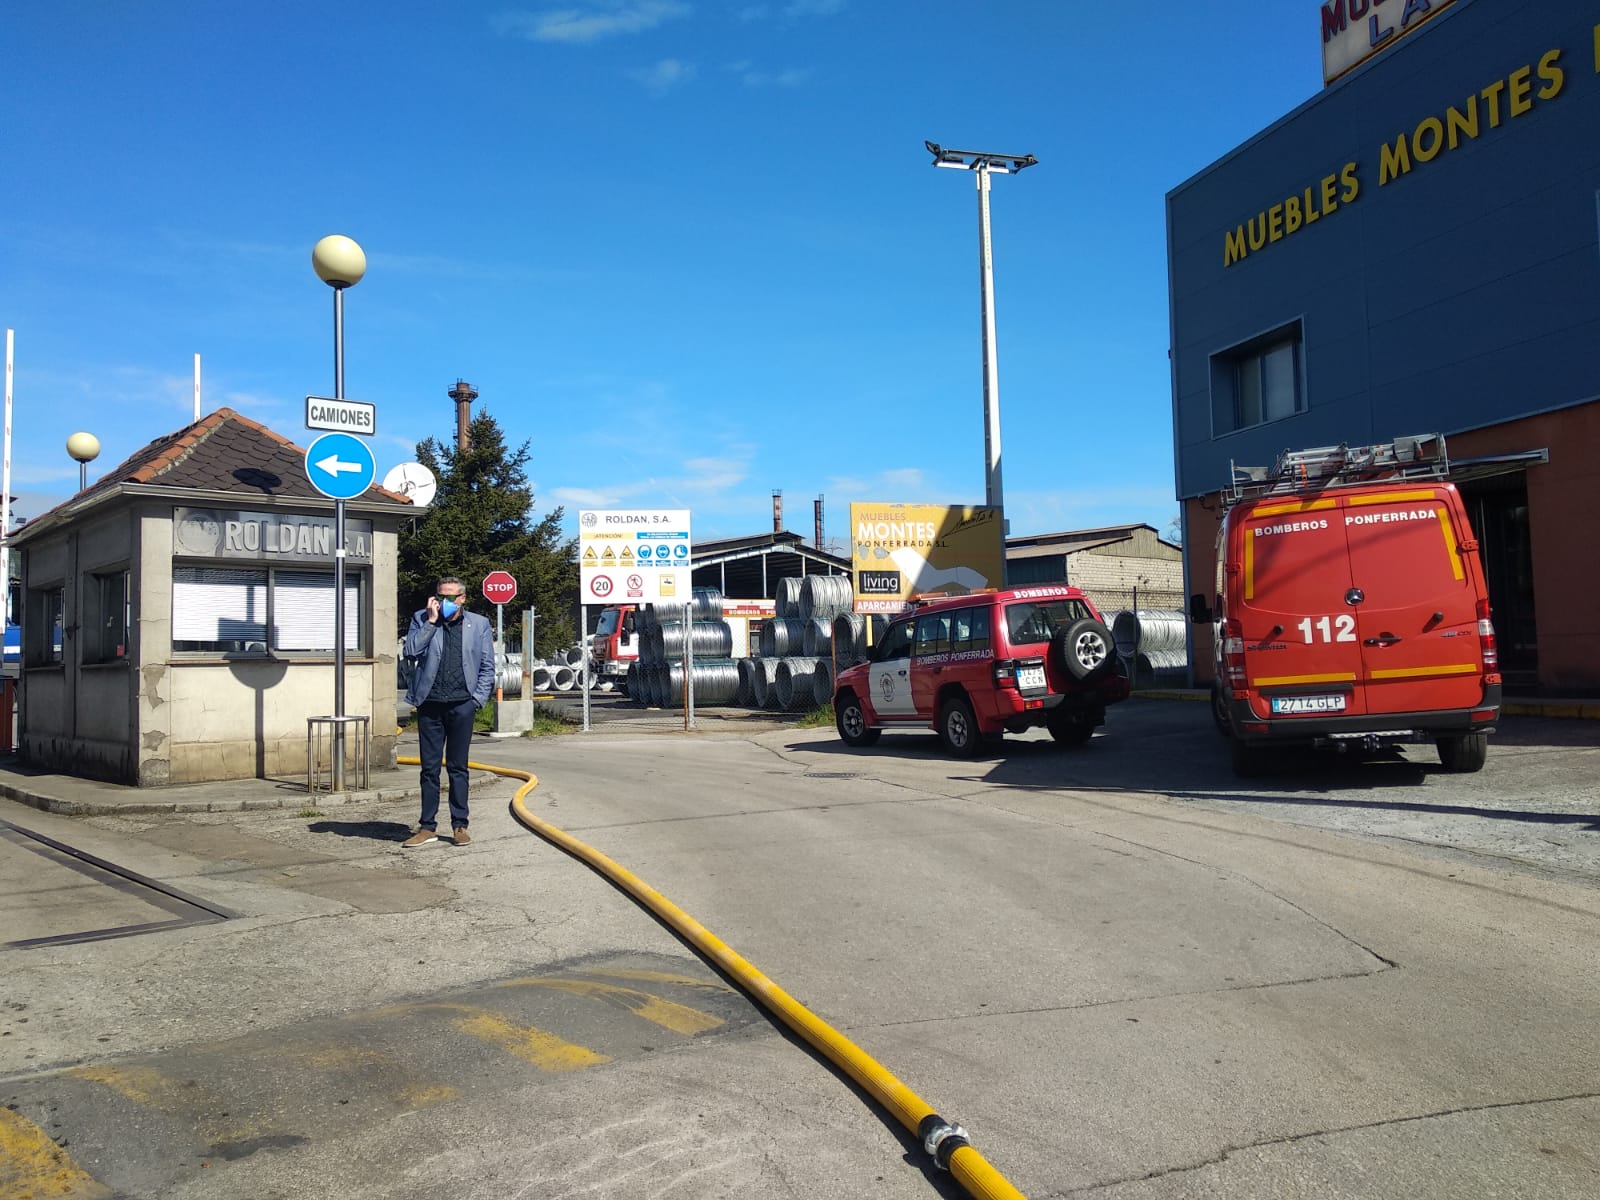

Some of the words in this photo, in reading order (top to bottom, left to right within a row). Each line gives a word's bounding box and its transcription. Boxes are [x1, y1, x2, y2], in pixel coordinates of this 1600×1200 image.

[1224, 162, 1359, 267] MUEBLES
[1378, 49, 1564, 186] MONTES
[310, 406, 370, 426] CAMIONES
[605, 515, 650, 524] ROLDAN,
[860, 512, 906, 520] MUEBLES
[1255, 519, 1328, 537] BOMBEROS
[1345, 509, 1437, 526] PONFERRADA
[225, 520, 330, 555] ROLDAN
[858, 522, 936, 539] MONTES
[857, 540, 932, 548] PONFERRADA
[487, 583, 513, 592] STOP
[595, 581, 609, 591] 20
[863, 573, 898, 591] living
[1014, 587, 1068, 599] BOMBEROS
[1298, 614, 1357, 644] 112
[916, 653, 949, 666] BOMBEROS
[950, 649, 995, 662] PONFERRADA
